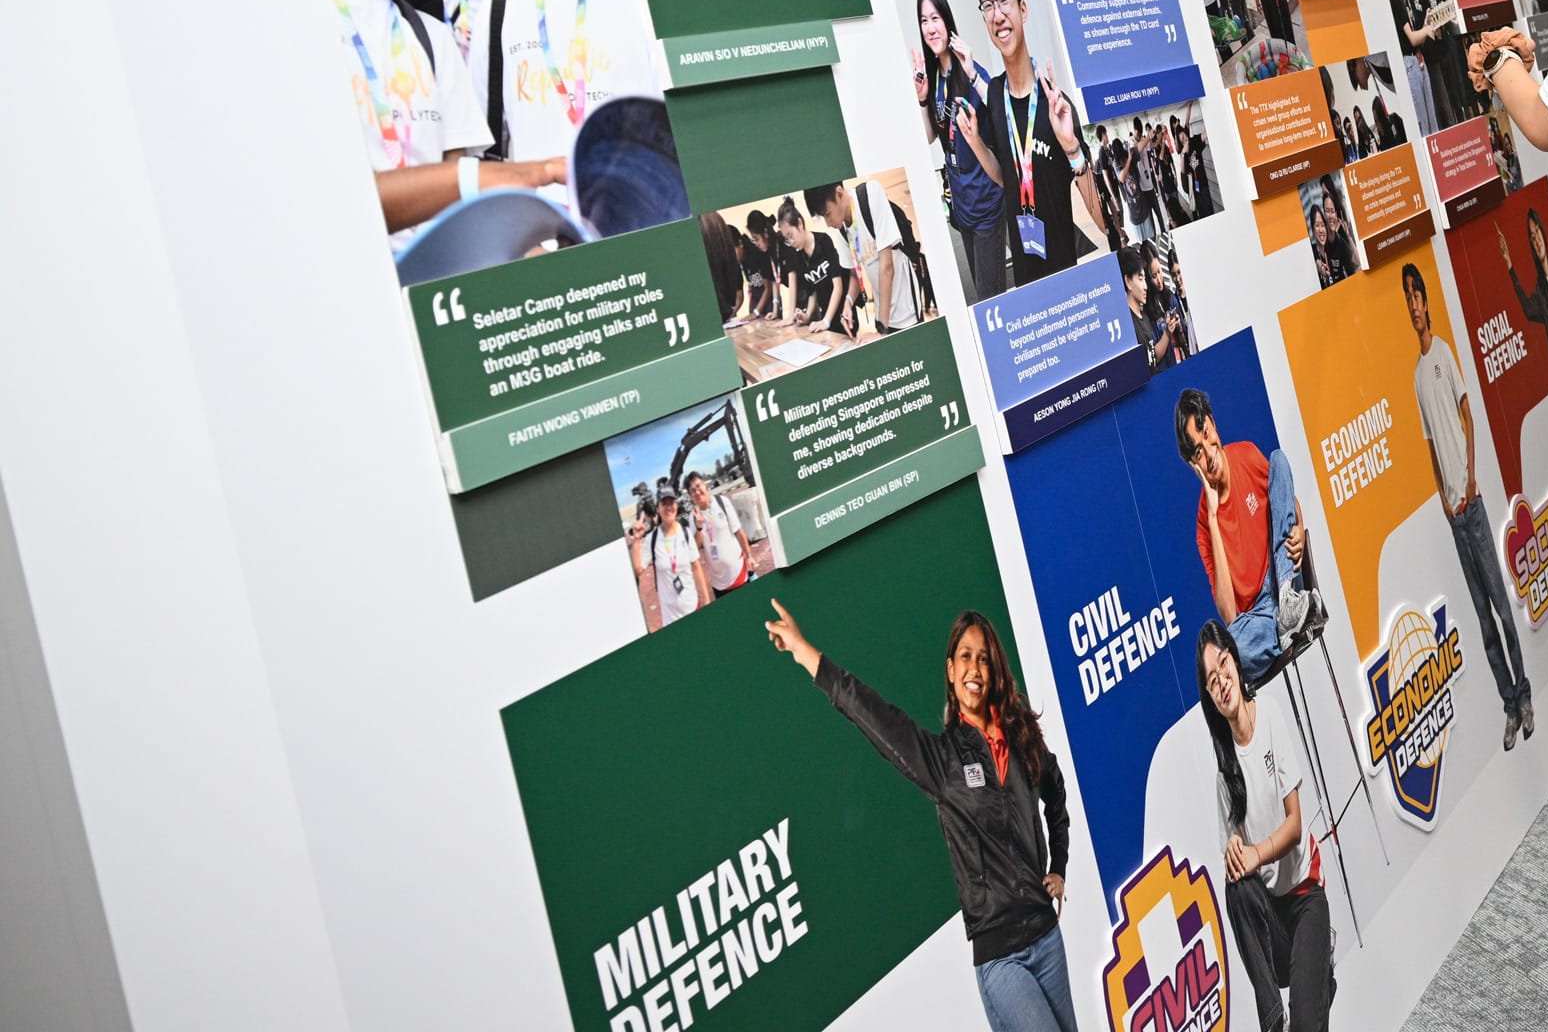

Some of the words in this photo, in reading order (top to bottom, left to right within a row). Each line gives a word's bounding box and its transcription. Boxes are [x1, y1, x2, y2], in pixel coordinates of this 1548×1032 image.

[681, 51, 715, 65] ARAVIN
[715, 49, 732, 60] S/O
[732, 48, 739, 58] V
[740, 40, 805, 56] NEDUNCHELIAN
[807, 37, 828, 50] (NYP)
[473, 306, 522, 329] Seletar
[525, 296, 564, 315] Camp
[567, 275, 627, 303] deepened
[628, 272, 646, 287] my
[480, 319, 564, 352] appreciation
[565, 312, 584, 326] for
[587, 298, 631, 320] military
[634, 289, 664, 306] roles
[1006, 319, 1022, 333] Civil
[1023, 311, 1048, 327] defence
[1048, 294, 1088, 316] responsibility
[1089, 283, 1111, 299] extends
[1010, 330, 1035, 349] beyond
[1036, 317, 1067, 338] uniformed
[1068, 304, 1099, 326] personnel;
[484, 346, 539, 374] through
[542, 330, 602, 356] engaging
[603, 320, 633, 337] talks
[635, 309, 658, 328] and
[1014, 347, 1041, 365] civilians
[1042, 338, 1058, 353] must
[1058, 336, 1067, 345] be
[1067, 325, 1089, 341] vigilant
[1089, 319, 1101, 331] and
[1477, 310, 1513, 354] SOCIAL
[1483, 331, 1528, 384] DEFENCE
[490, 381, 508, 396] an
[510, 367, 542, 389] M3G
[544, 358, 576, 378] boat
[577, 351, 605, 368] ride.
[784, 402, 820, 423] Military
[877, 367, 911, 390] passion
[911, 361, 923, 372] for
[1018, 359, 1047, 383] prepared
[1047, 356, 1060, 367] too.
[509, 424, 543, 446] FAITH
[543, 411, 580, 433] WONG
[580, 397, 619, 419] YAWEN
[620, 390, 640, 408] (TP)
[789, 415, 838, 442] defending
[839, 396, 885, 421] Singapore
[886, 375, 930, 402] impressed
[793, 447, 812, 461] me,
[814, 428, 854, 452] showing
[855, 408, 901, 434] dedication
[903, 395, 933, 414] despite
[1034, 406, 1055, 422] AESON
[1054, 397, 1071, 411] YONG
[1072, 393, 1081, 403] JIA
[1080, 384, 1097, 398] RONG
[1097, 379, 1108, 392] (TP)
[798, 457, 834, 479] diverse
[835, 430, 896, 463] backgrounds.
[1321, 398, 1393, 473] ECONOMIC
[815, 505, 847, 528] DENNIS
[847, 497, 864, 511] TEO
[865, 485, 888, 503] GUAN
[889, 478, 903, 492] BIN
[904, 471, 919, 487] (SP)
[1329, 436, 1393, 508] DEFENCE
[1068, 585, 1132, 657] CIVIL
[1078, 596, 1181, 706] DEFENCE
[1368, 628, 1462, 765] ECONOMIC
[1395, 690, 1453, 778] DEFENCE
[593, 817, 792, 1012] MILITARY
